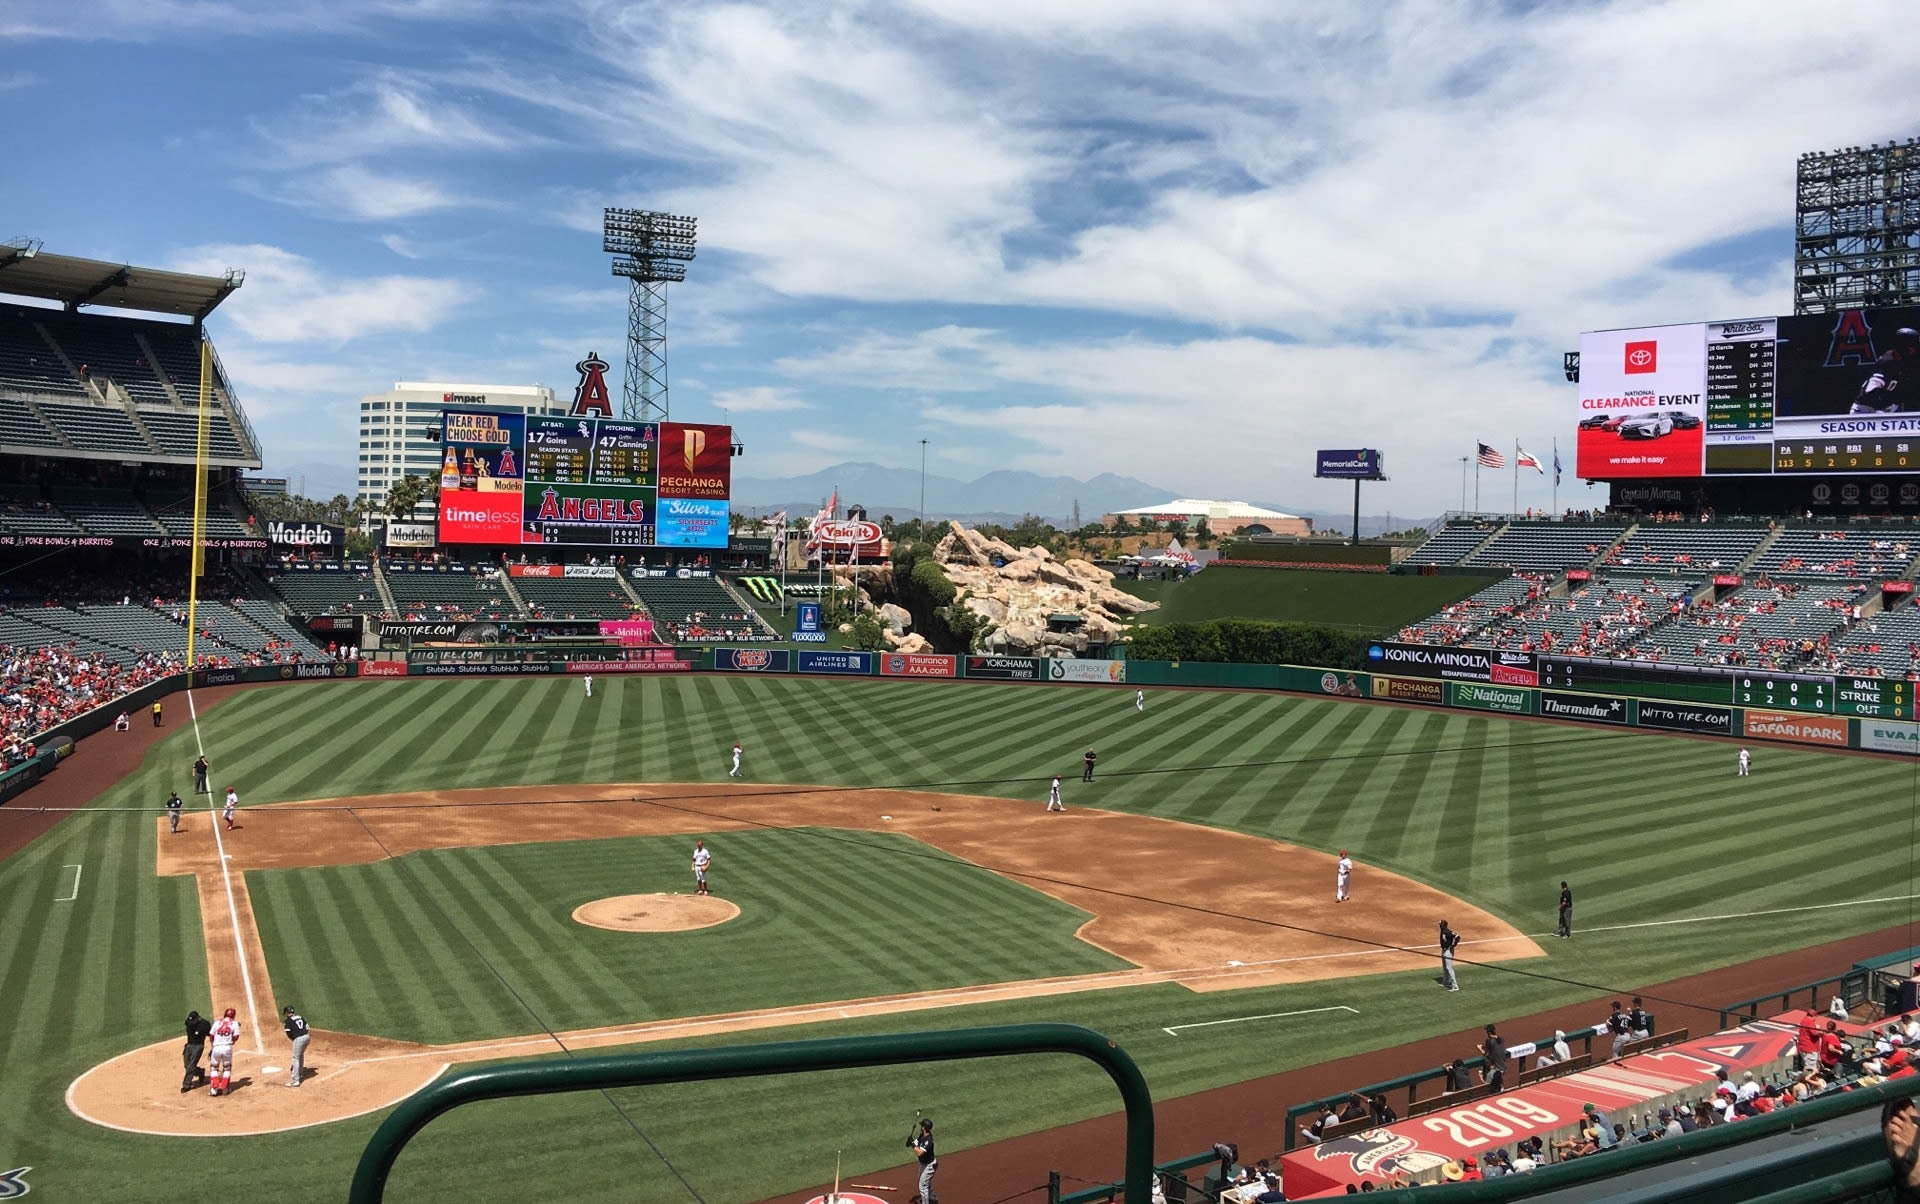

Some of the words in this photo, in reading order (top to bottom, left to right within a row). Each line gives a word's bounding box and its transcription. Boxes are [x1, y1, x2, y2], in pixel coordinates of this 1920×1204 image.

[451, 392, 486, 403] impact
[1582, 396, 1656, 409] CLEARANCE
[1658, 394, 1700, 406] EVENT
[448, 415, 472, 428] WEAR
[476, 416, 496, 430] RED,
[1820, 422, 1876, 433] SEASON
[448, 428, 482, 441] CHOOSE
[486, 430, 509, 442] GOLD
[528, 432, 545, 443] 17
[600, 436, 617, 447] 47
[618, 441, 648, 450] Canning
[1780, 446, 1791, 454] PA
[1803, 446, 1815, 454] 2B
[1825, 445, 1837, 454] HR
[1846, 444, 1862, 453] RBI
[1875, 444, 1882, 453] R
[1897, 444, 1909, 452] SB
[1778, 459, 1794, 468] 113
[1805, 459, 1812, 467] 5
[1828, 459, 1834, 467] 2
[1900, 457, 1906, 465] 0
[494, 480, 522, 490] Modelo
[661, 477, 724, 488] PECHANGA
[1620, 487, 1649, 501] Captain
[1650, 487, 1681, 501] Morgan
[536, 485, 644, 522] ANGELS
[670, 500, 710, 515] Silver
[446, 506, 520, 523] timeless
[268, 521, 331, 544] Modelo
[392, 528, 429, 541] Modelo
[196, 539, 220, 547] OWLS
[230, 539, 268, 548] BURRITOS
[909, 656, 948, 665] Insurance
[1384, 648, 1432, 664] KONICA
[1434, 653, 1490, 669] MINOLTA
[1500, 652, 1516, 661] White
[571, 662, 604, 670] AMERICA'S
[986, 659, 1033, 668] YOKOHAMA
[297, 665, 330, 677] Modelo
[909, 666, 948, 675] AAA.com
[1441, 670, 1490, 680] RESHAPEWORK.COM
[1495, 668, 1533, 684] ANGELS
[1566, 666, 1572, 674] 0
[207, 674, 235, 683] Fanatics
[1546, 677, 1552, 685] 0
[1566, 678, 1572, 686] 3
[1391, 681, 1440, 693] PECHANGA
[1744, 679, 1751, 688] 0
[1766, 681, 1773, 690] 0
[1791, 683, 1797, 692] 0
[1816, 686, 1823, 694] 1
[1854, 680, 1880, 691] BALL
[1895, 684, 1902, 692] 0
[1473, 688, 1524, 704] National
[1767, 695, 1774, 704] 2
[1790, 697, 1797, 706] 0
[1816, 700, 1823, 708] 0
[1841, 692, 1880, 703] STRIKE
[1895, 696, 1902, 704] 0
[1544, 699, 1610, 717] Thermador
[1856, 704, 1880, 714] OUT
[1895, 708, 1902, 717] 0
[1641, 707, 1674, 719] NITTO
[1677, 711, 1729, 725] TIRE.COM
[1749, 721, 1800, 736] SAFARI
[1802, 727, 1842, 740] PARK
[1874, 729, 1906, 739] EVA
[1422, 1096, 1560, 1148] 2019
[1362, 1141, 1405, 1165] AMERICAN
